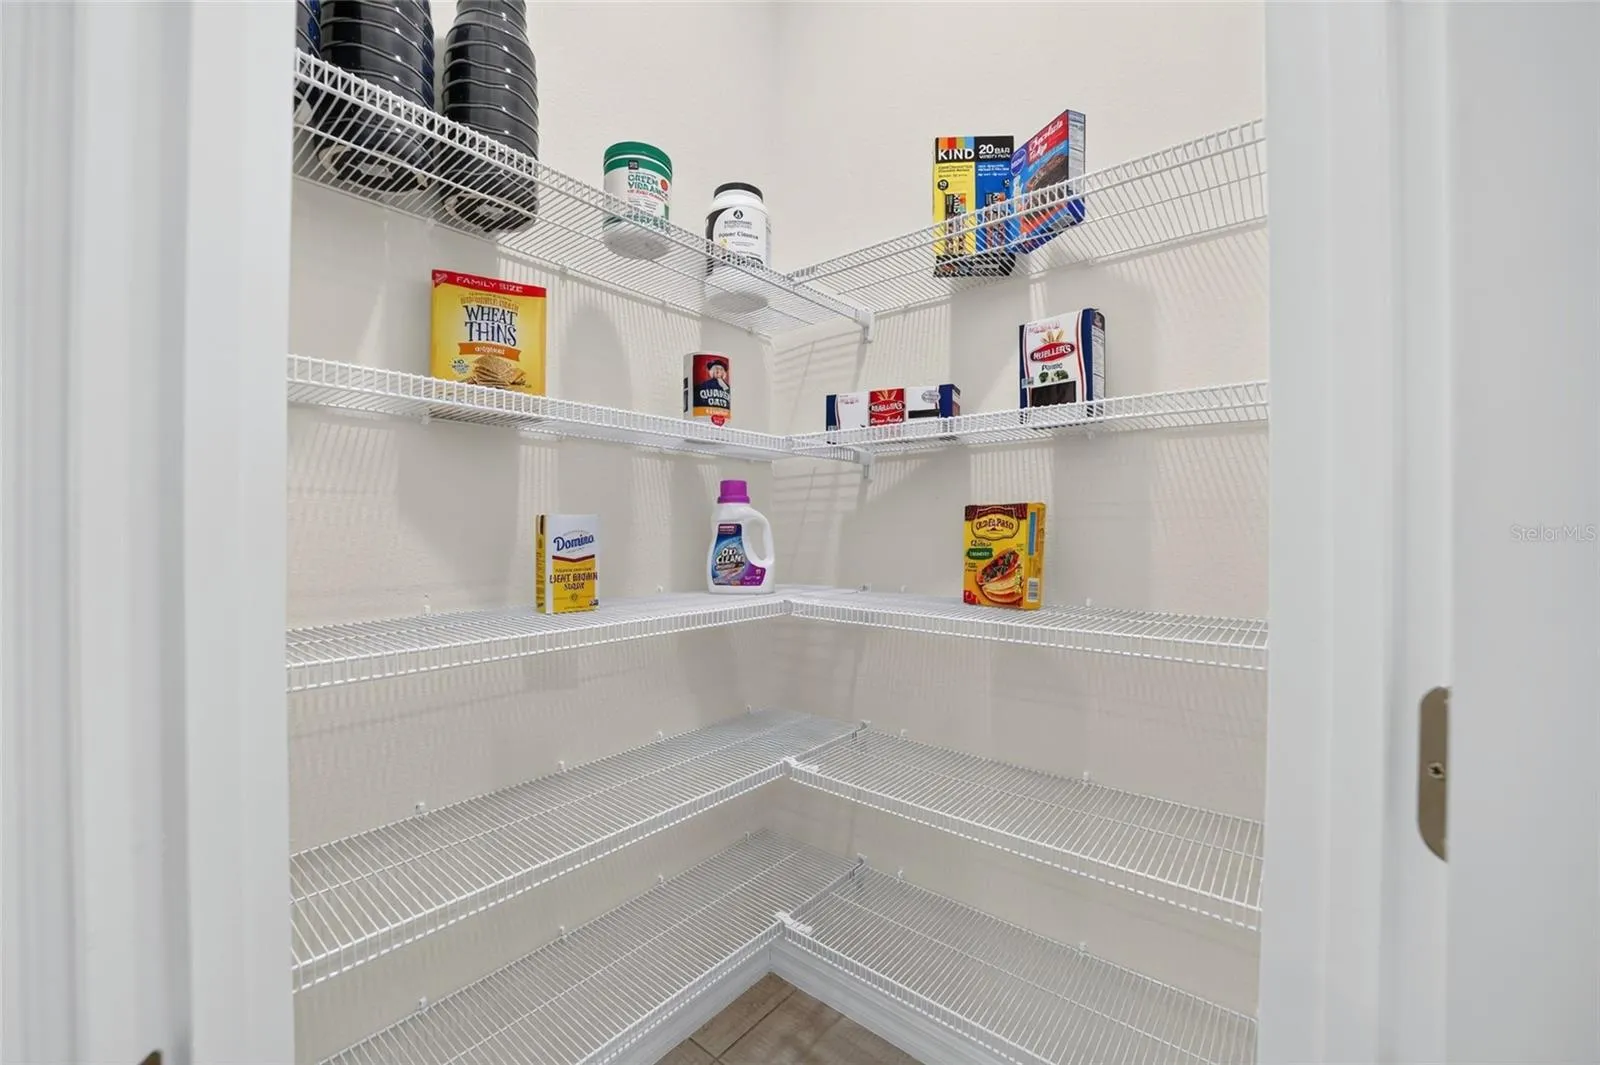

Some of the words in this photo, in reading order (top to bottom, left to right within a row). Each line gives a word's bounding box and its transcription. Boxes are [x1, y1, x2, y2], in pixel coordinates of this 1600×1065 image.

[937, 148, 975, 161] KIND
[978, 144, 994, 155] 20
[994, 147, 1011, 155] BAR
[456, 276, 497, 290] FAMILY
[499, 283, 524, 293] SIZE
[463, 304, 519, 327] WHEAT
[707, 398, 727, 407] OATS
[553, 533, 595, 552] Domino
[549, 573, 571, 584] LIGHT
[572, 571, 599, 582] BROWN
